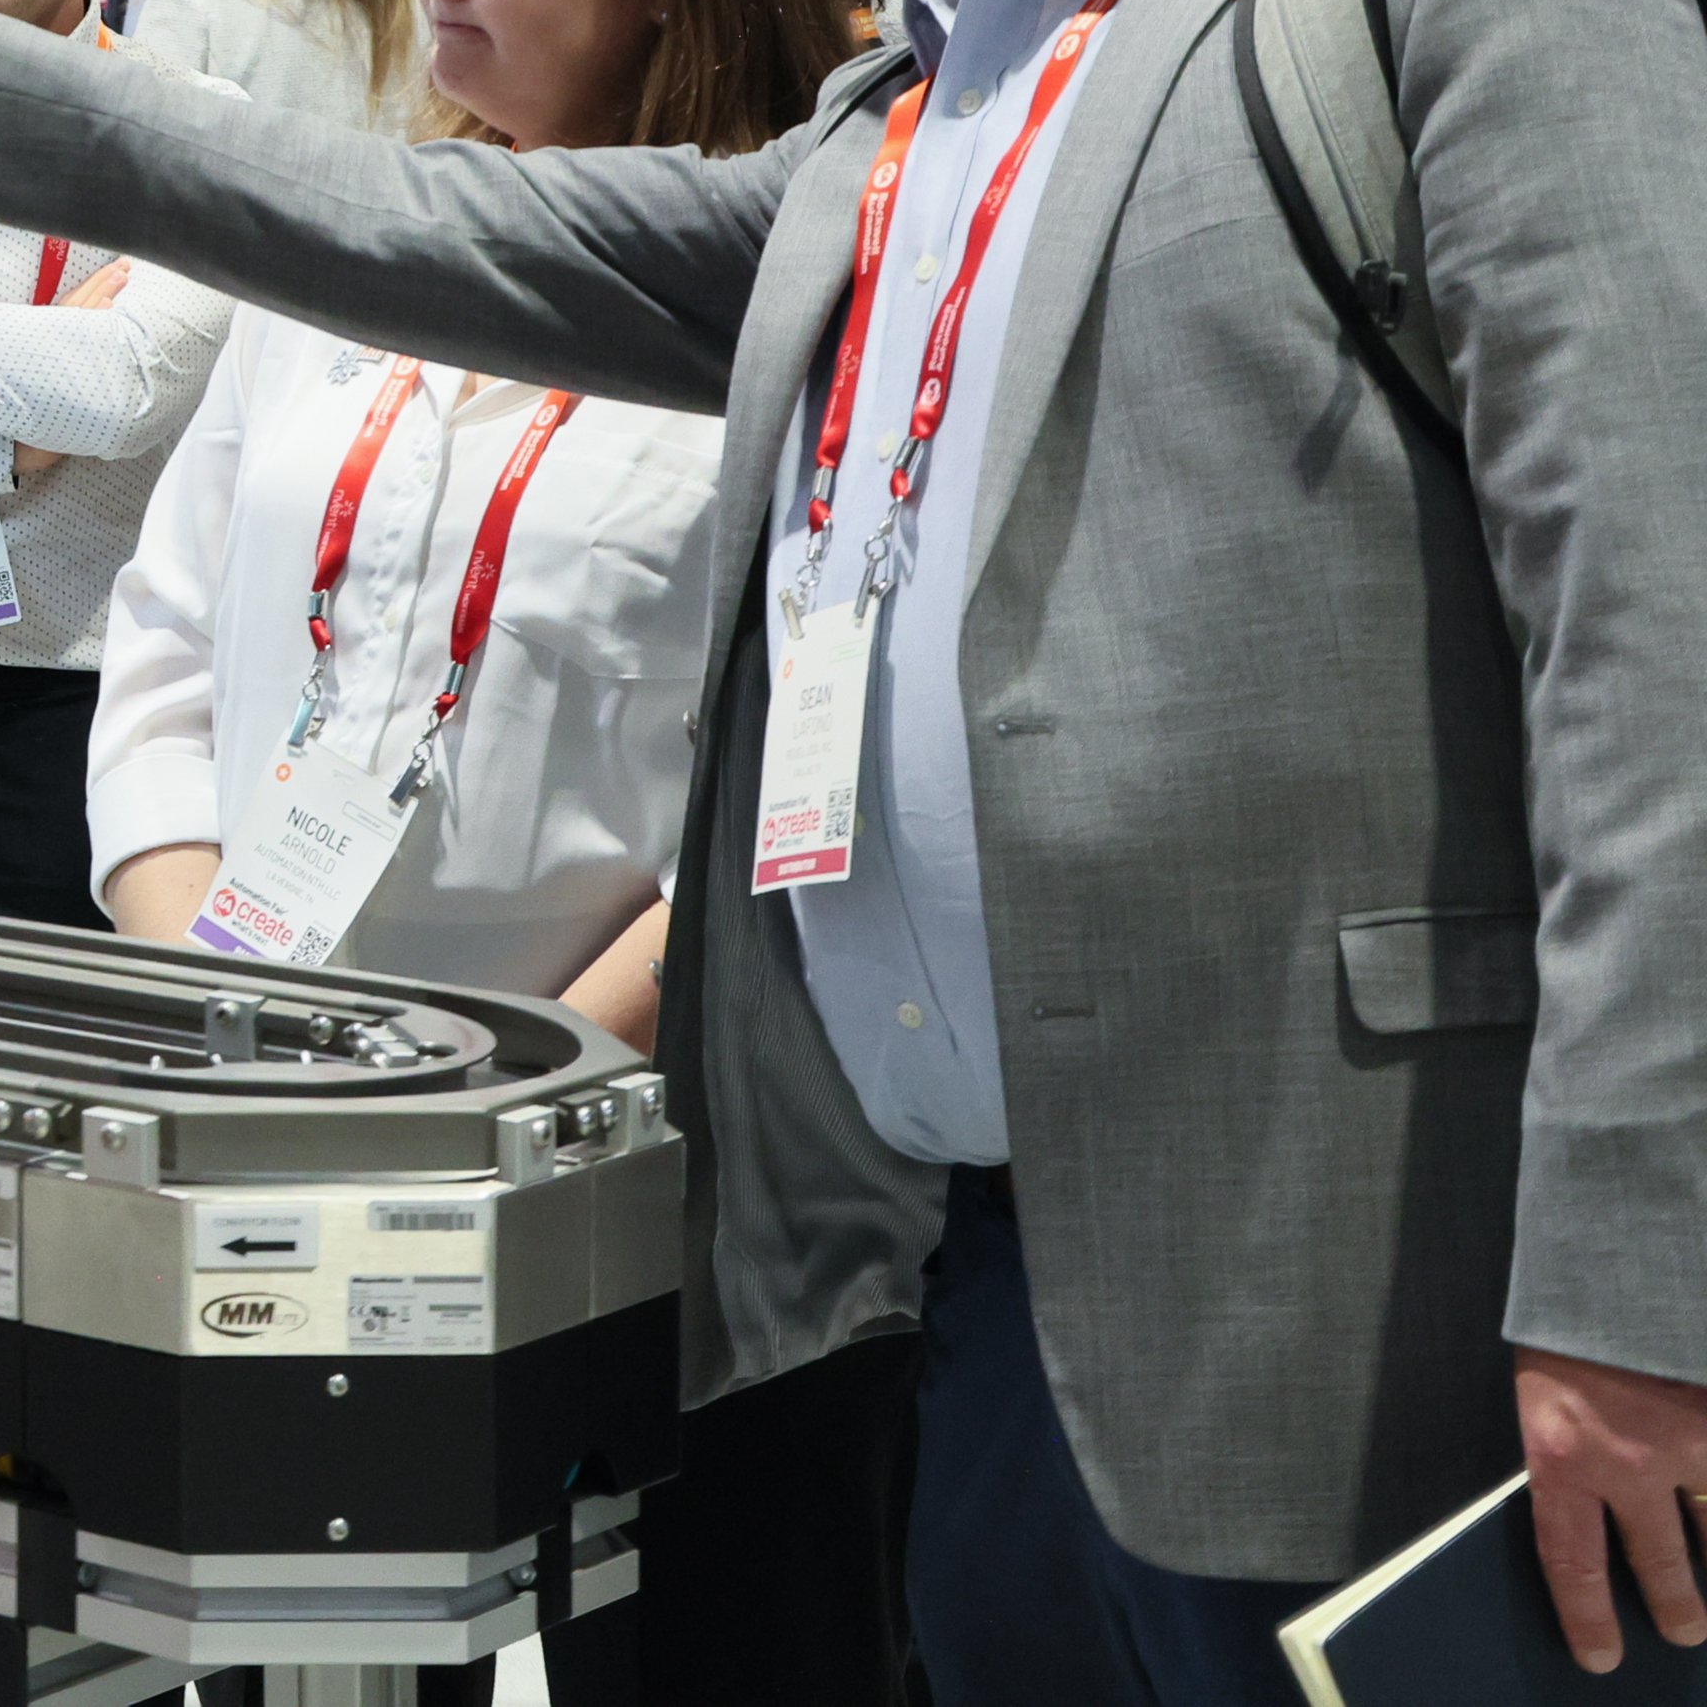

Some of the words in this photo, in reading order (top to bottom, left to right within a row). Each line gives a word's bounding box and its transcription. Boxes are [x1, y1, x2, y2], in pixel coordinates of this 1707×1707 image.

[860, 193, 878, 275] Automation
[872, 192, 889, 257] Rockwell
[928, 303, 950, 372] Rockwell
[935, 286, 966, 372] Automation
[363, 380, 394, 438] Automation
[376, 379, 406, 427] Rockwell
[499, 430, 532, 491] Automation
[516, 429, 545, 480] Rockwell
[798, 681, 834, 712] SEAN
[285, 805, 353, 856] NICOLE
[776, 806, 822, 838] create
[279, 833, 337, 876] ARNOLD
[228, 878, 272, 909] Automation
[237, 900, 294, 947] create
[218, 1301, 277, 1326] MM
